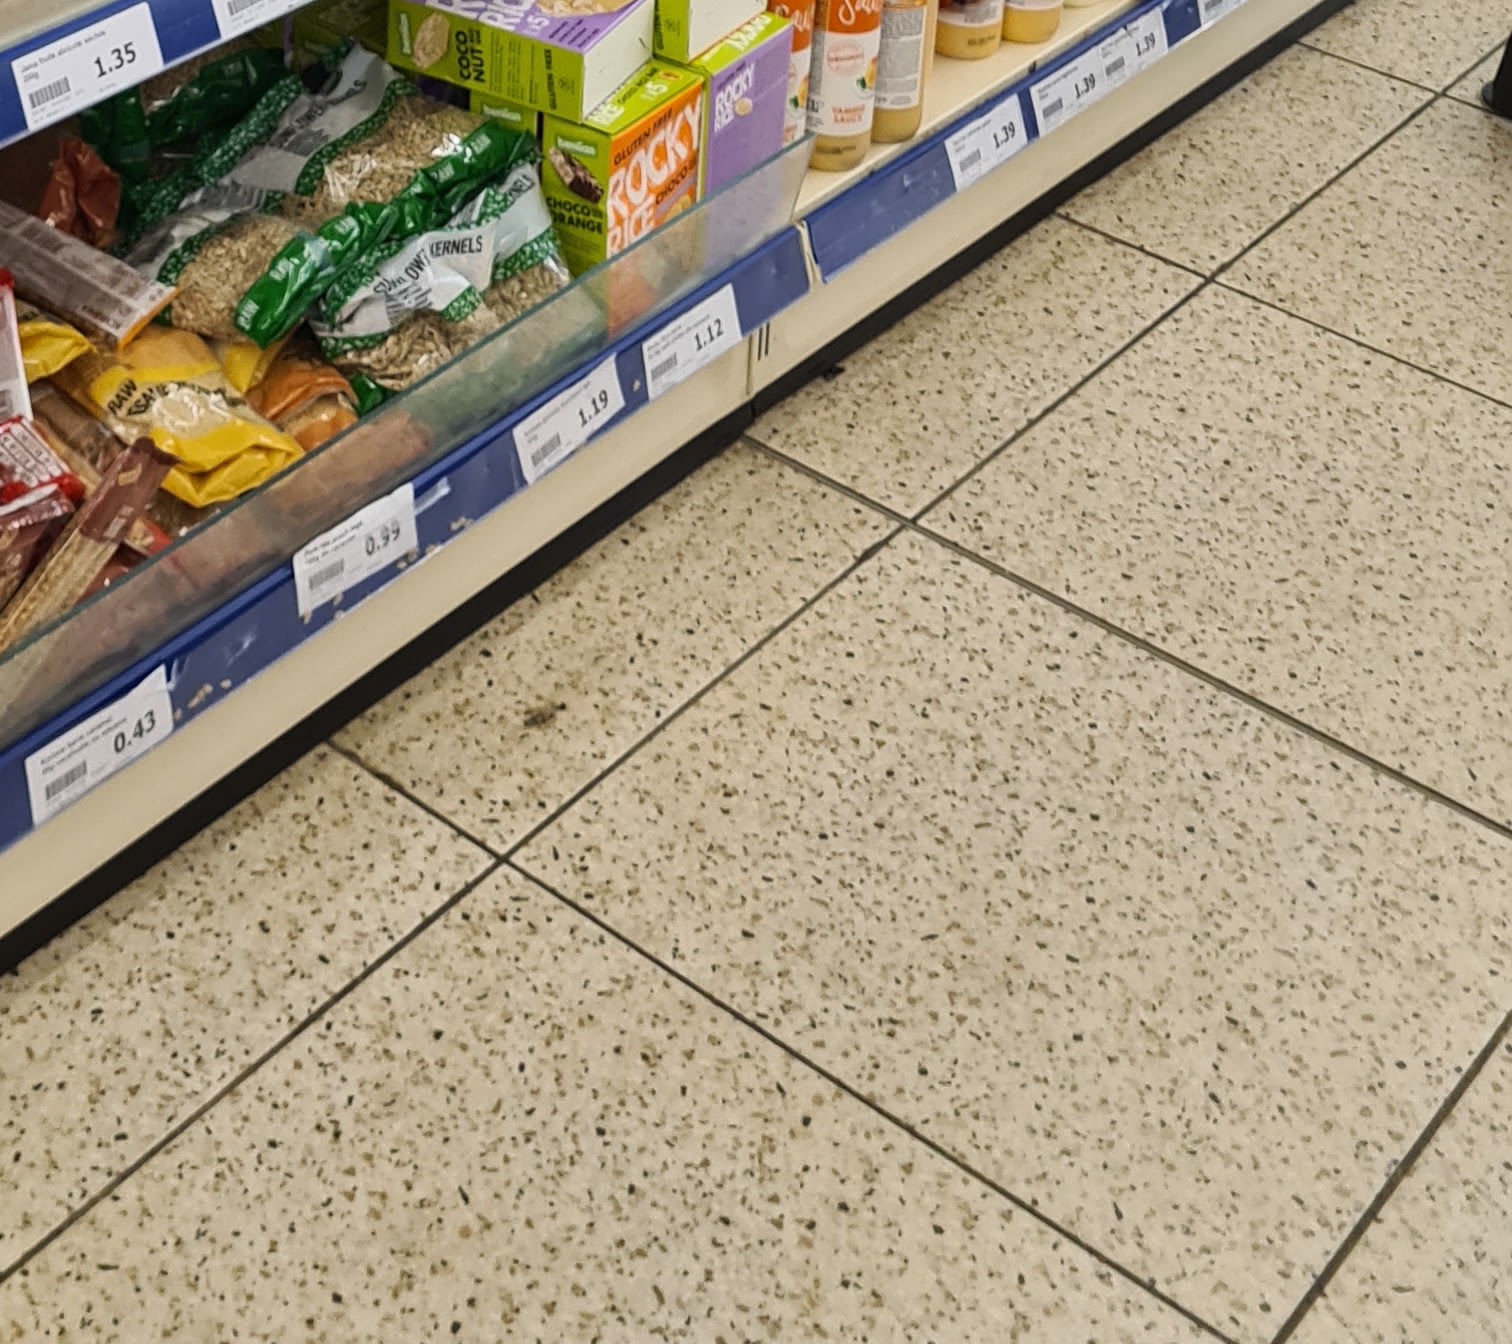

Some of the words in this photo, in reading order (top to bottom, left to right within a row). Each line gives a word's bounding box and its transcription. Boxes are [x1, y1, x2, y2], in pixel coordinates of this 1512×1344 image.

[94, 42, 138, 79] 1.35
[454, 30, 470, 81] COCO
[1073, 72, 1097, 101] 1.39
[992, 120, 1017, 149] 1.39
[608, 94, 702, 226] ROCKY
[429, 235, 483, 257] KERNELS
[693, 317, 725, 350] 1.12
[577, 388, 611, 424] 1.19
[113, 711, 158, 754] 0.43
